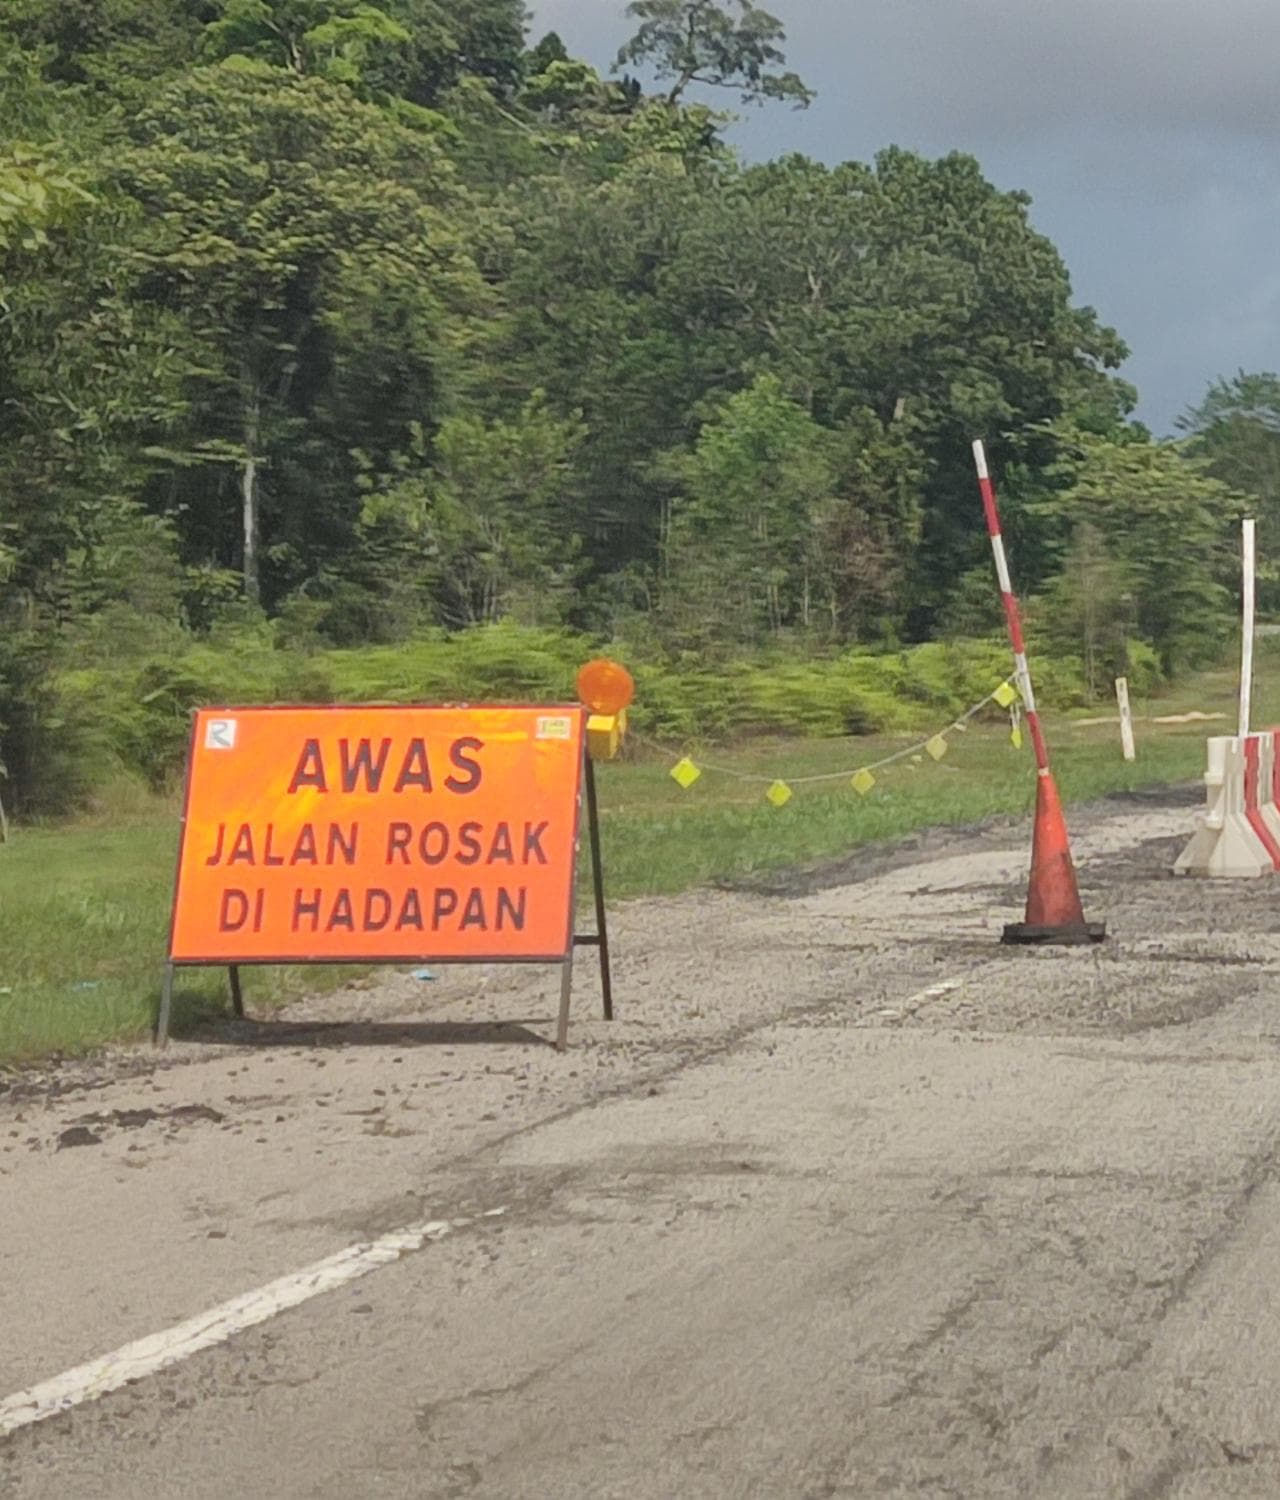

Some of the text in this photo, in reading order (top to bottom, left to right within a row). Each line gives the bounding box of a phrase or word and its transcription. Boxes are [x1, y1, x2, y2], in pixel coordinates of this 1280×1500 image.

[288, 737, 485, 794] AWAS
[205, 821, 550, 866] JALAN ROSAK
[218, 887, 527, 933] DI HADAPAN
